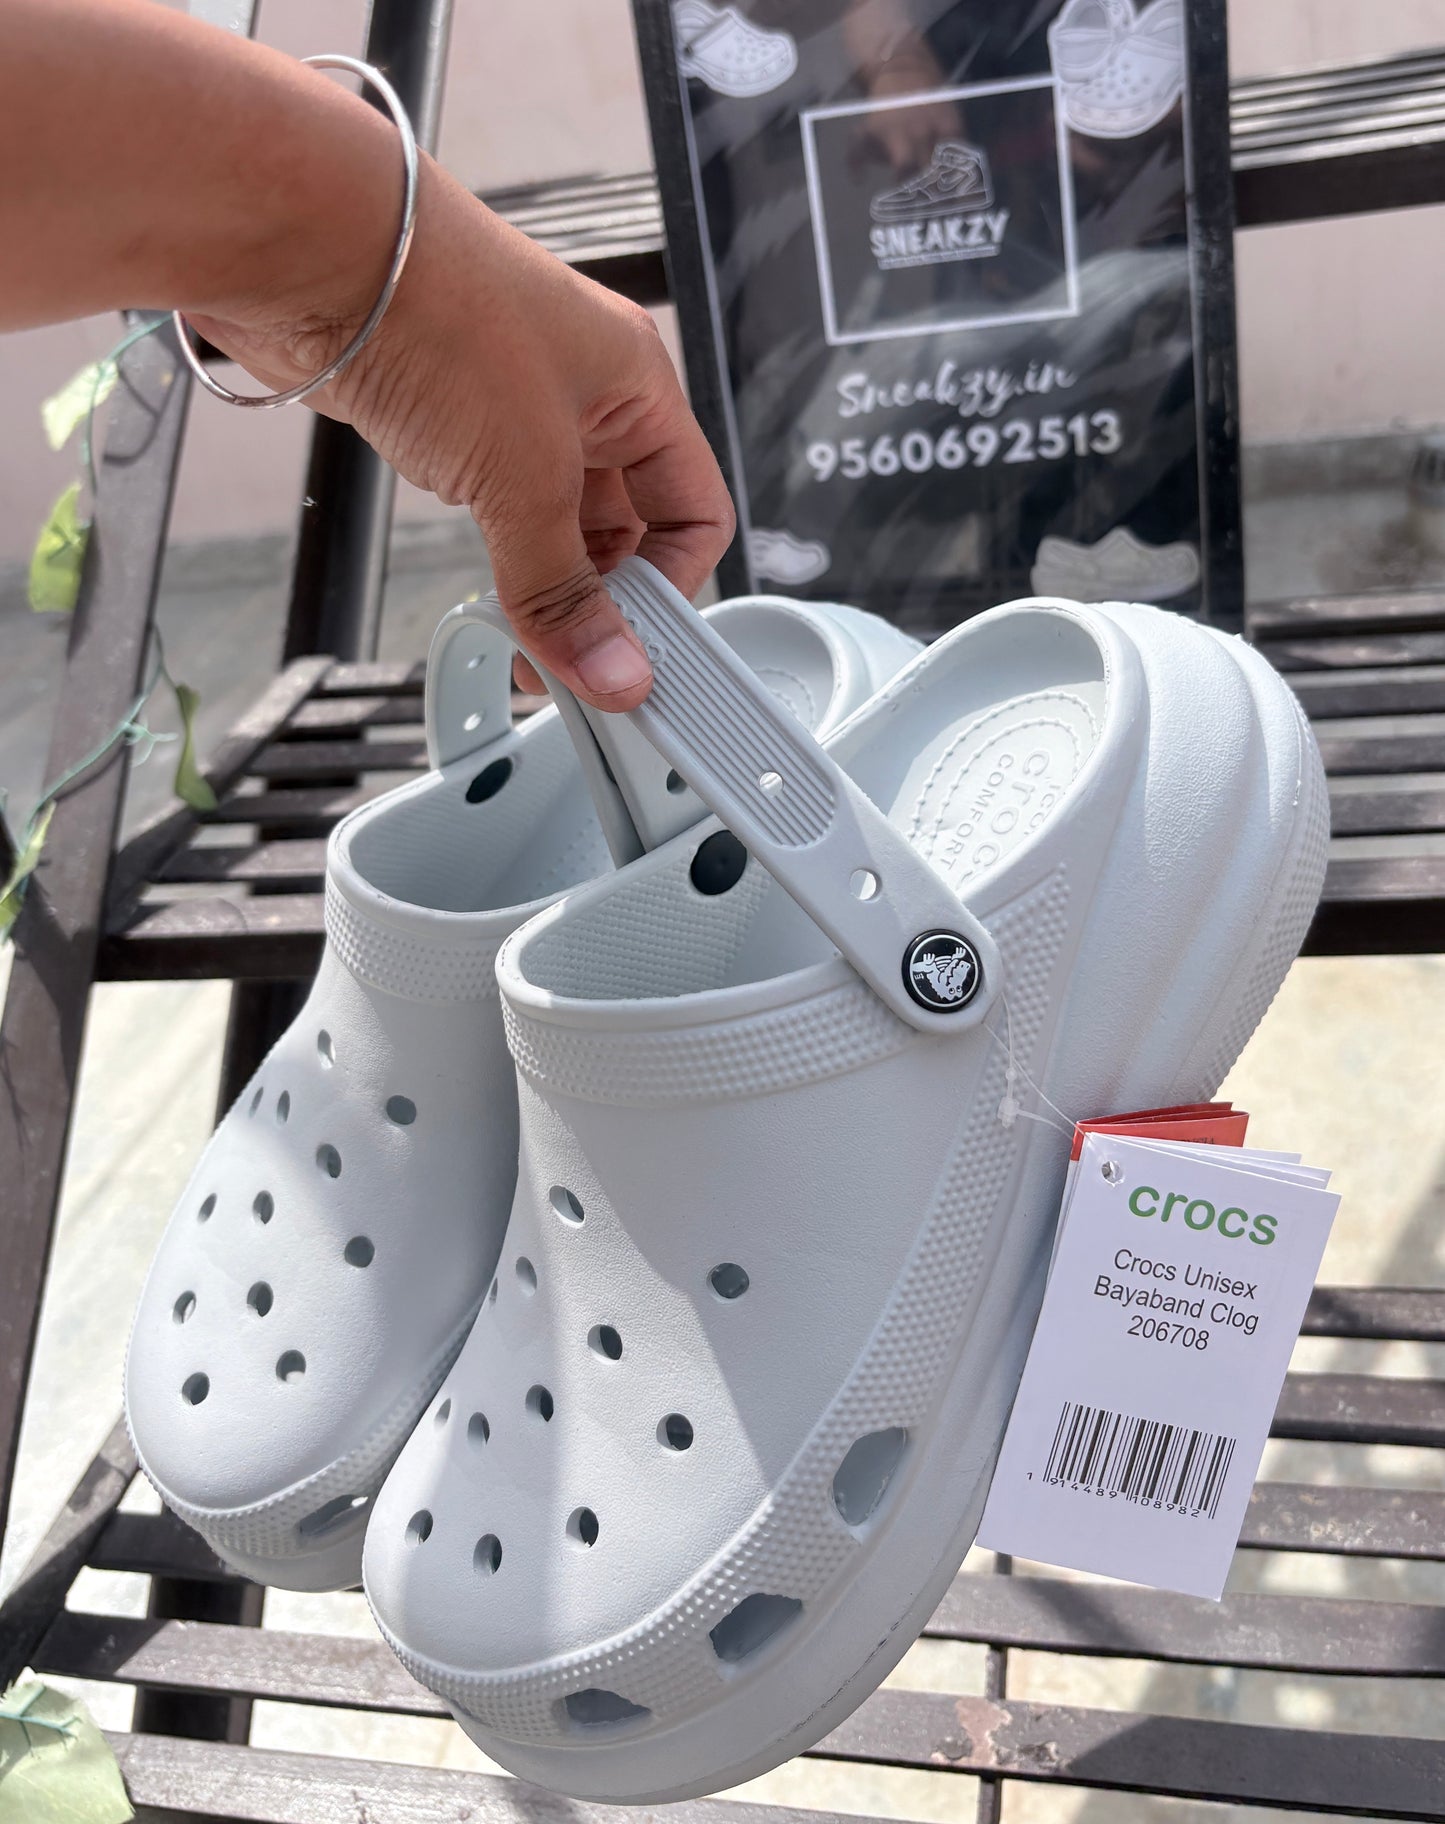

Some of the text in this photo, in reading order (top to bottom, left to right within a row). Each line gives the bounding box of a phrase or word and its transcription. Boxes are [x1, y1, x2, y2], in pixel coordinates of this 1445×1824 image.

[869, 209, 1010, 258] SNEAKZY
[836, 359, 1078, 418] Sneakzy.in
[805, 409, 1122, 481] 9560692513
[939, 753, 1014, 870] COMFORT
[1128, 1185, 1278, 1245] crocs
[1114, 1249, 1258, 1300] Crocs Unisex
[1094, 1275, 1259, 1336] Bayaband Clog
[1127, 1315, 1209, 1351] 206708
